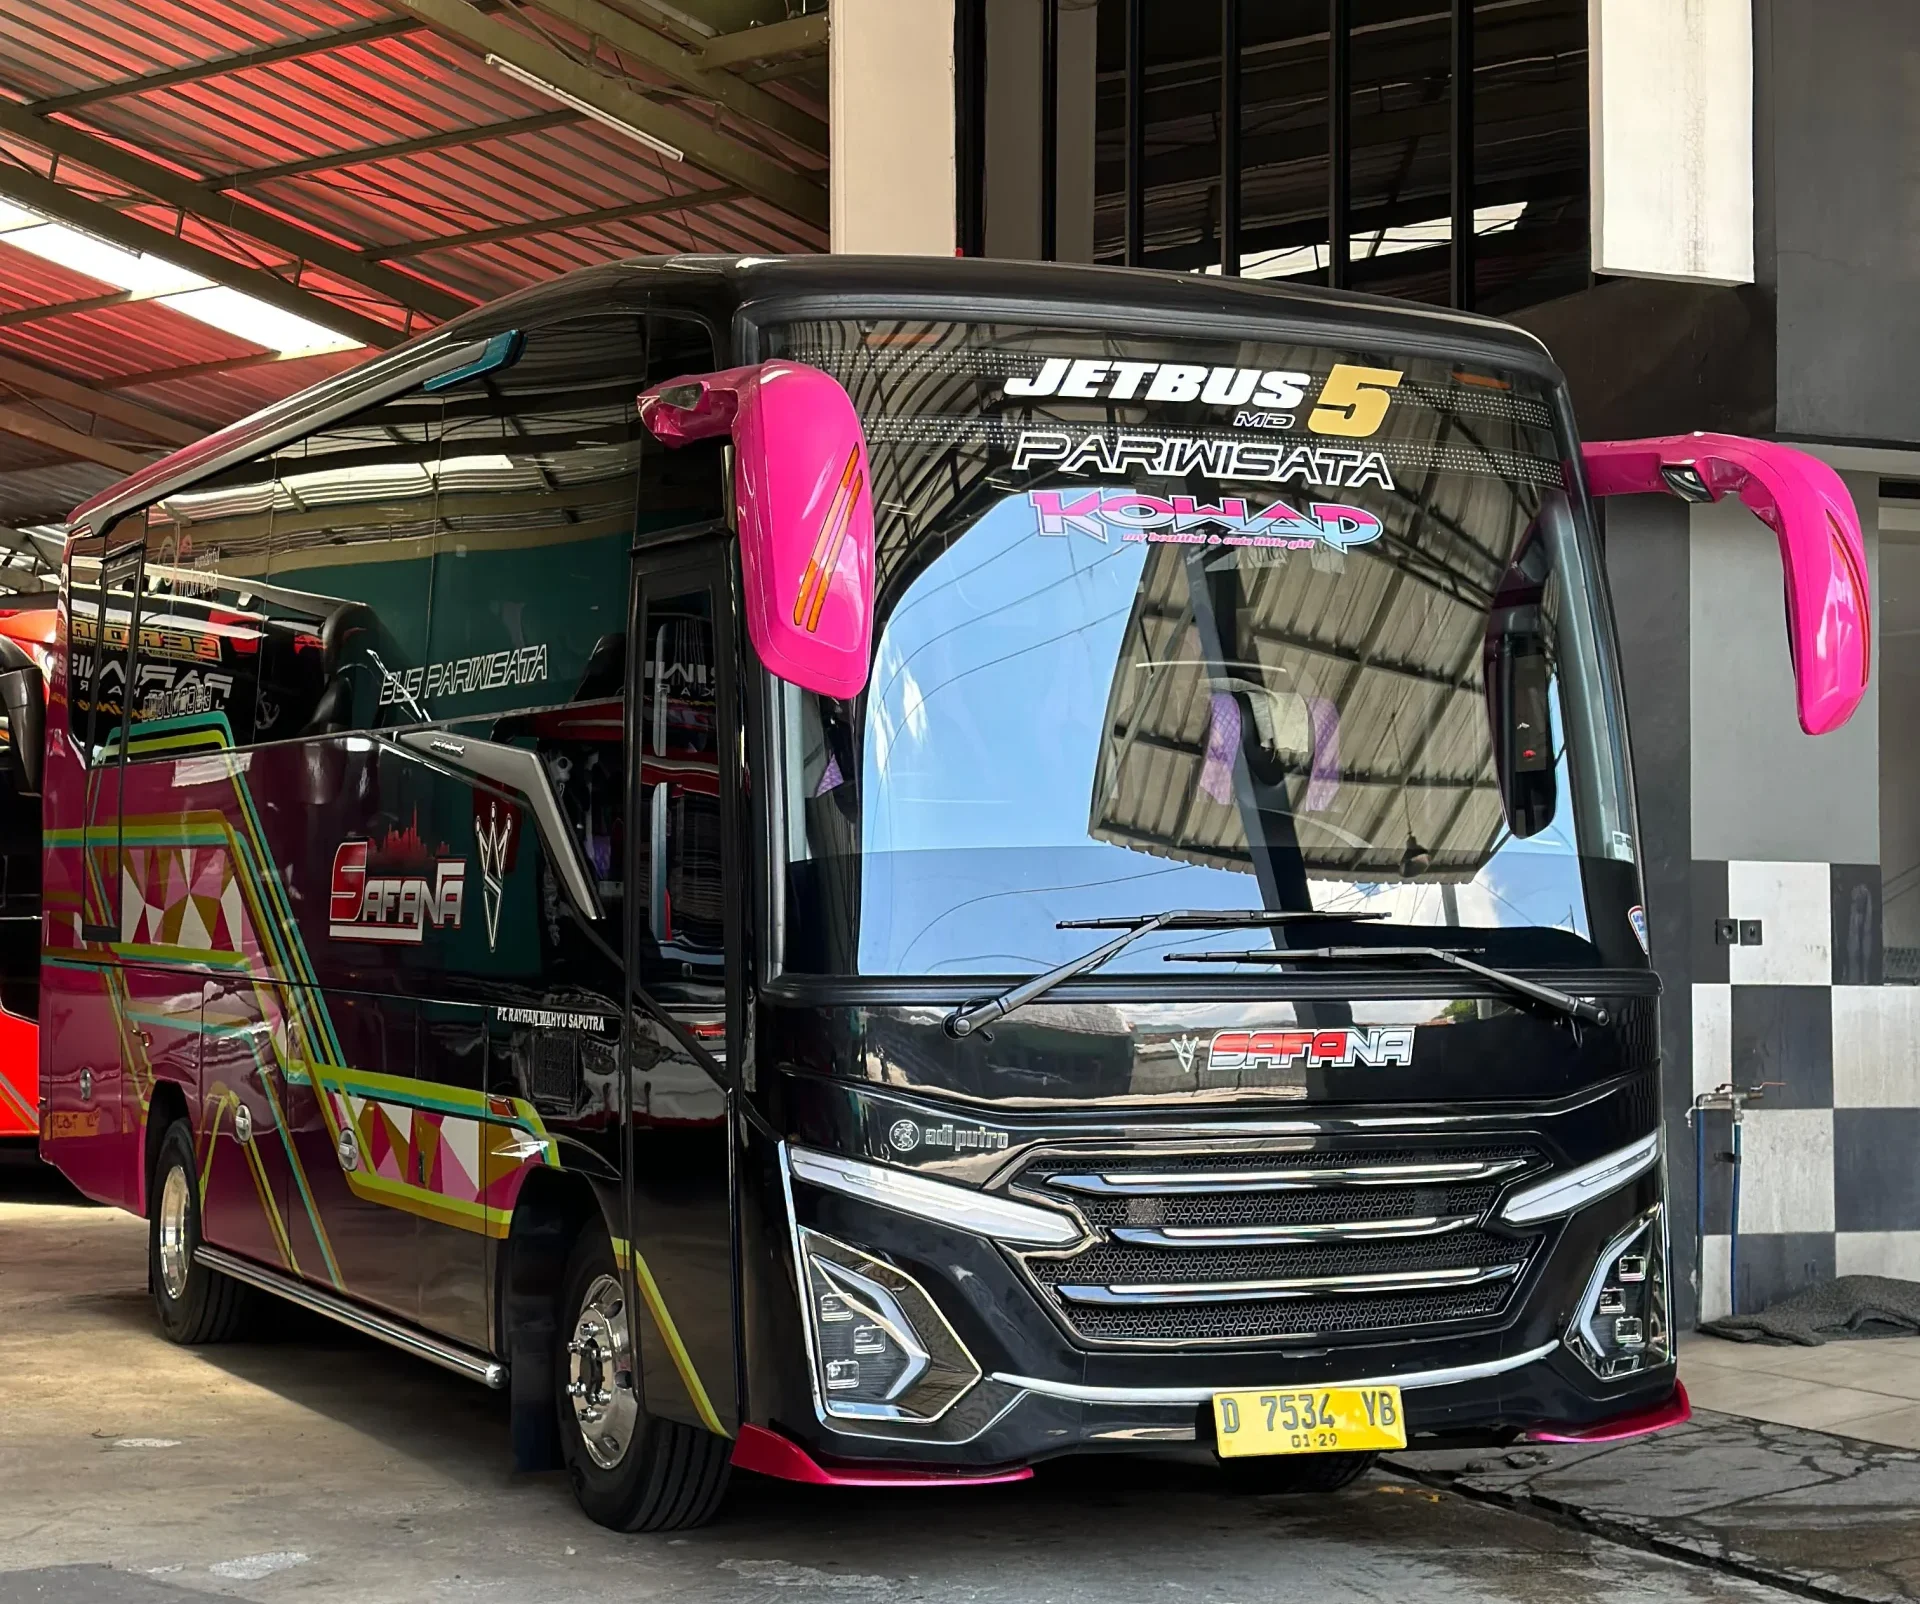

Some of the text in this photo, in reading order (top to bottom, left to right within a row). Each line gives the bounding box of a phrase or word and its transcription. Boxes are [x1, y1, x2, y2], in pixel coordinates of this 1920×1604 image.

[1003, 358, 1404, 437] JETBUS 5
[1233, 411, 1296, 429] MD
[1011, 431, 1396, 491] PARIWISATA
[1122, 533, 1148, 544] my
[1207, 534, 1221, 545] &
[1287, 539, 1316, 550] girl
[379, 643, 549, 706] BUS PARIWISATA
[329, 841, 467, 943] SAFANA
[568, 1013, 605, 1032] SAPUTRA
[1206, 1026, 1417, 1071] SAFANA
[925, 1124, 1009, 1152] adi putro
[1219, 1390, 1397, 1434] D 7534 YB
